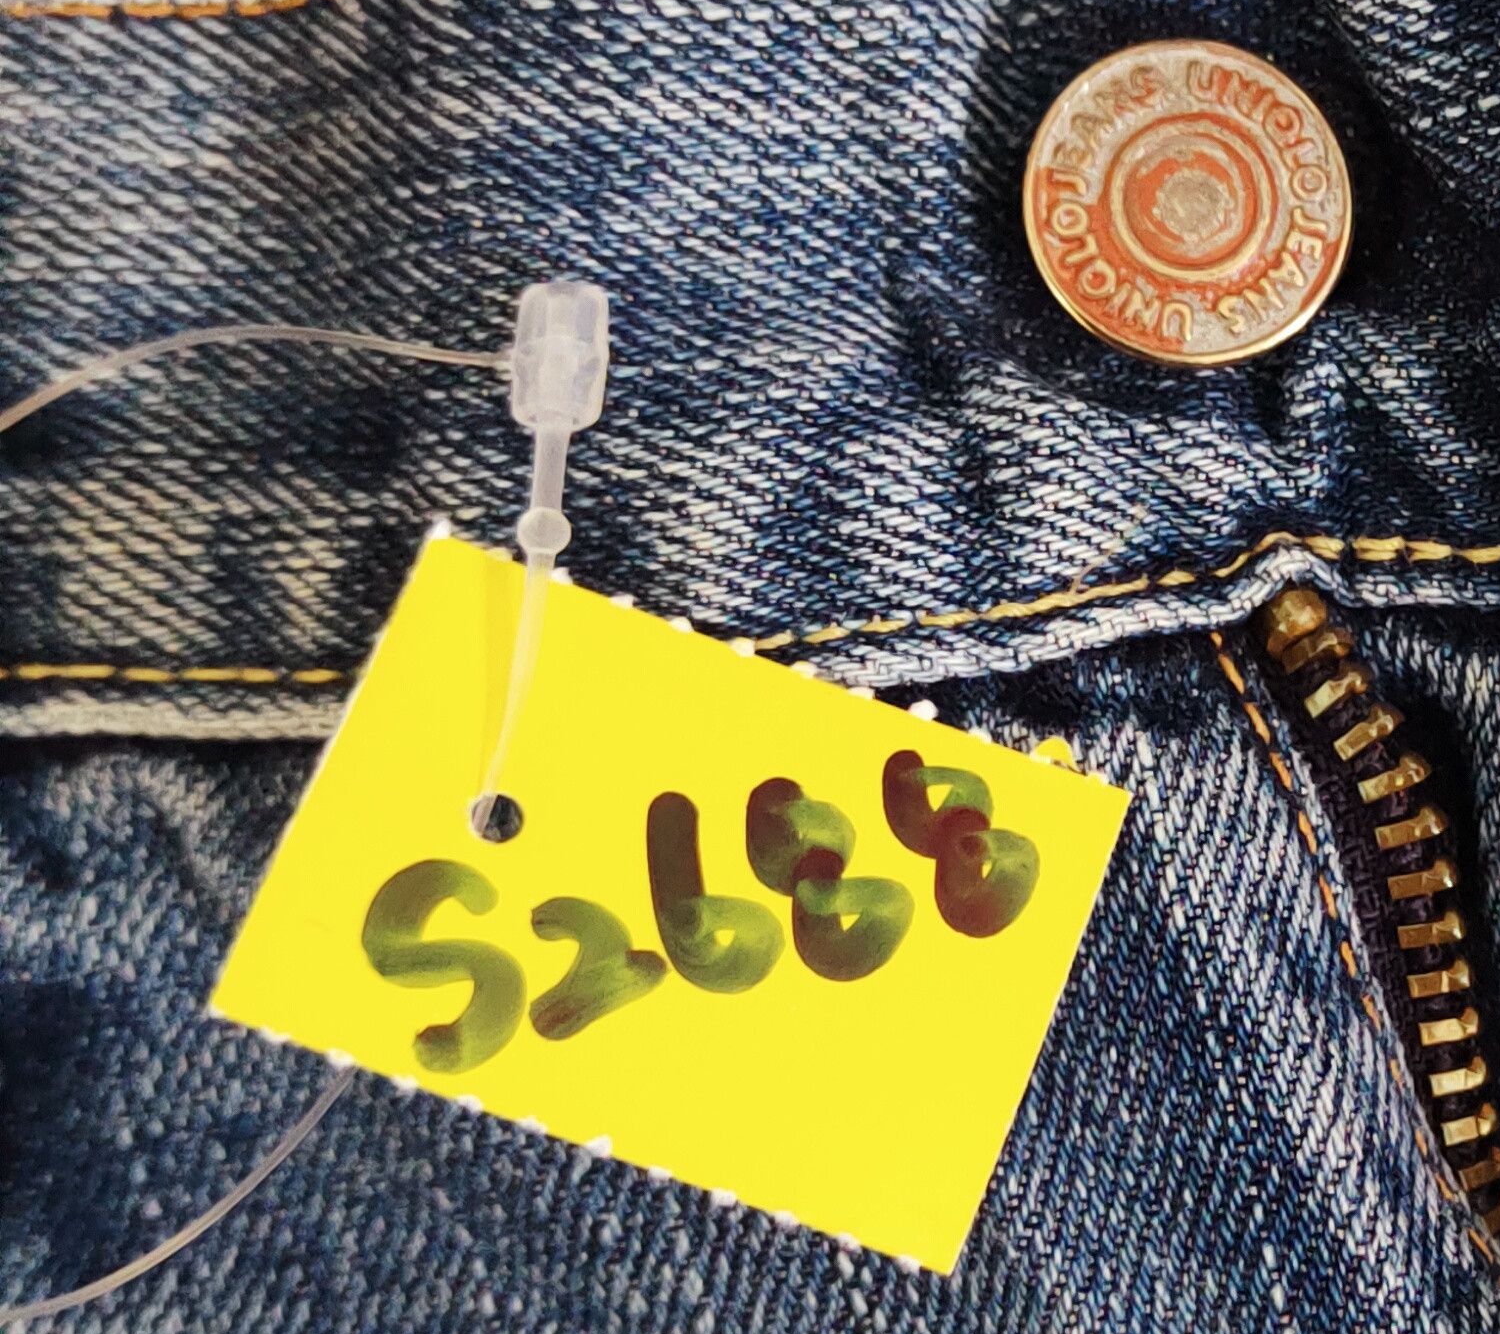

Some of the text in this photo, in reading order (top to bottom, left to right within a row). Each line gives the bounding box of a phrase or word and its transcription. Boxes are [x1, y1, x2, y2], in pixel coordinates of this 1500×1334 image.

[1047, 198, 1193, 342] UNIQLO
[1186, 60, 1329, 336] UNIQLO JEANS
